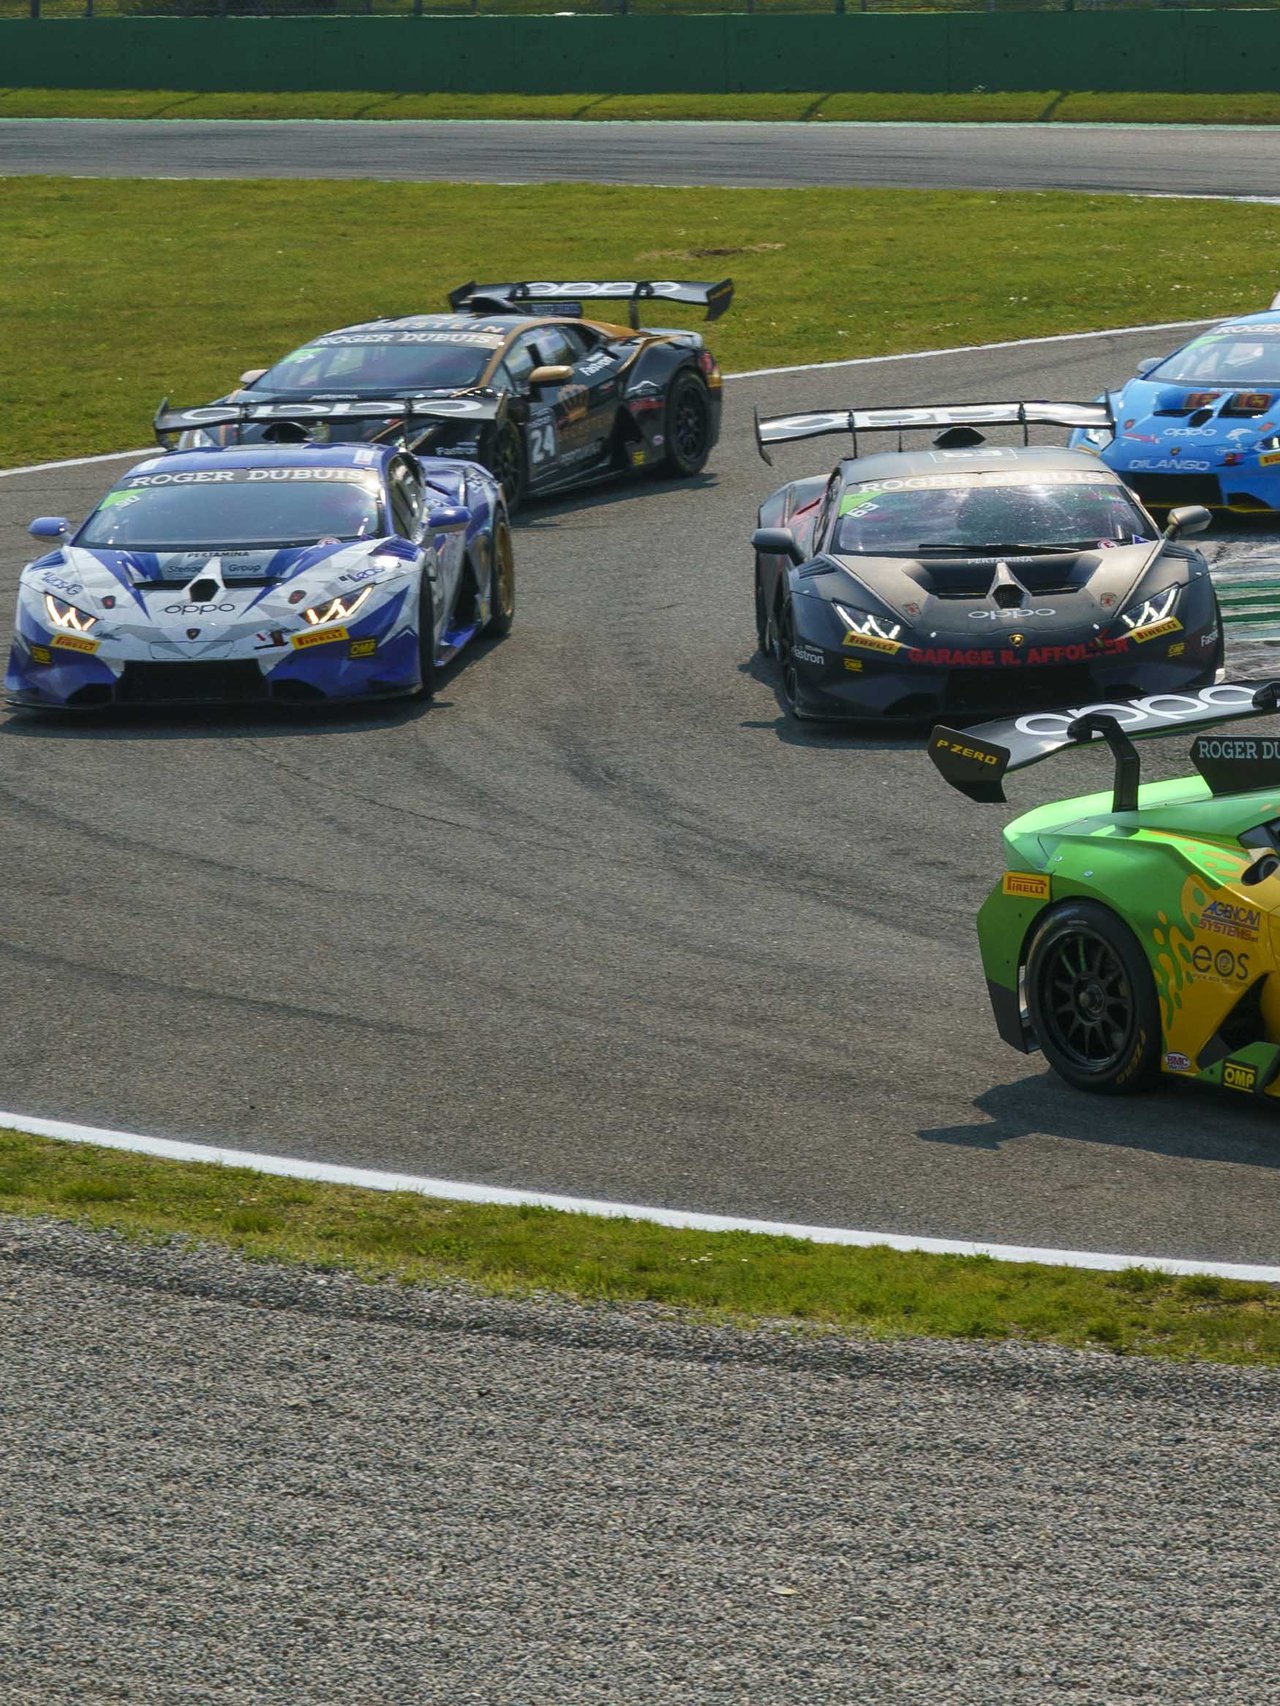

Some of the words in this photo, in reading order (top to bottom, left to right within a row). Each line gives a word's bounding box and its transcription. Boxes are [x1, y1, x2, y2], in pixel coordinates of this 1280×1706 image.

[314, 333, 393, 346] ROGER
[399, 331, 491, 344] DUBUIS
[1162, 426, 1218, 437] oppo
[1128, 458, 1211, 471] DILANGO
[128, 471, 234, 488] ROGER
[246, 469, 363, 482] DUBUIS
[860, 473, 974, 493] ROGER
[986, 470, 1106, 486] DUBUIS
[846, 502, 881, 519] 63
[967, 555, 1034, 564] PERTAMINA
[228, 563, 261, 574] Group
[164, 603, 236, 616] oppo
[967, 607, 1057, 620] oppo
[297, 629, 344, 646] PIRELLI
[907, 647, 996, 666] GARAGE
[1001, 649, 1021, 664] R.
[1027, 640, 1131, 663] AFFOLER
[1015, 683, 1258, 738] oppo
[936, 738, 949, 749] P
[950, 744, 999, 766] ZERO
[1199, 741, 1257, 759] ROGER
[1006, 876, 1048, 896] PIRELLI
[1192, 944, 1250, 981] eos
[1224, 1067, 1255, 1088] OMP
